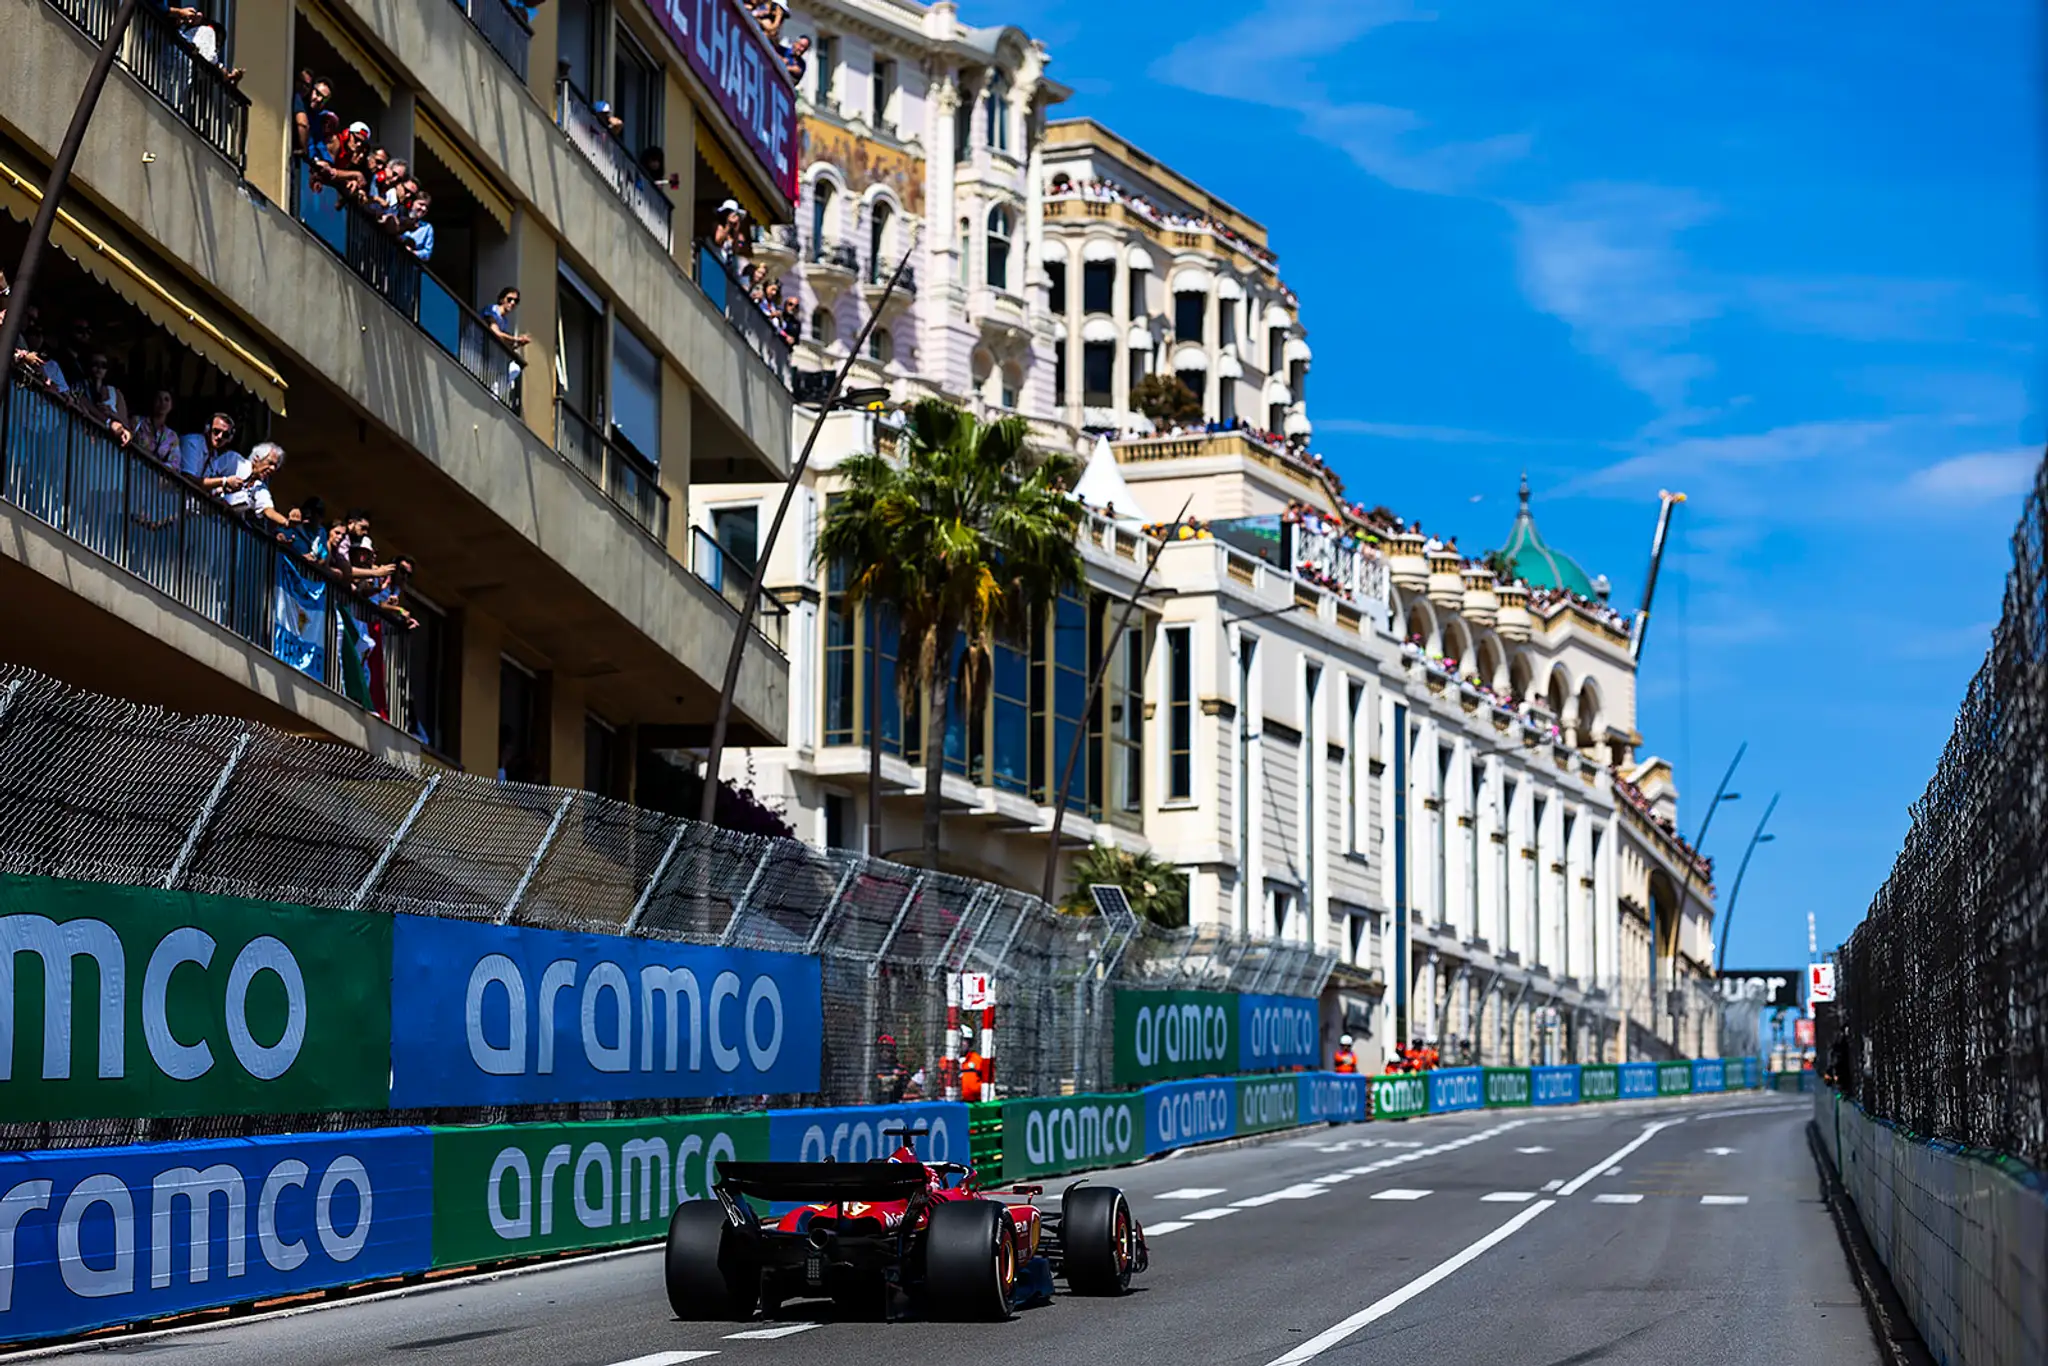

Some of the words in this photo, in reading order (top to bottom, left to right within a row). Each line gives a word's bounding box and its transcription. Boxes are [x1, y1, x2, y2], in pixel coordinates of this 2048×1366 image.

[0, 913, 307, 1080] mco
[465, 953, 784, 1074] aramco
[1135, 1004, 1228, 1067] aramco
[1252, 1006, 1313, 1057] aramco
[1026, 1103, 1132, 1165] aramco
[1158, 1088, 1228, 1142] aramco
[1243, 1082, 1296, 1126] aramco
[487, 1132, 736, 1239] aramco
[0, 1155, 373, 1312] ramco
